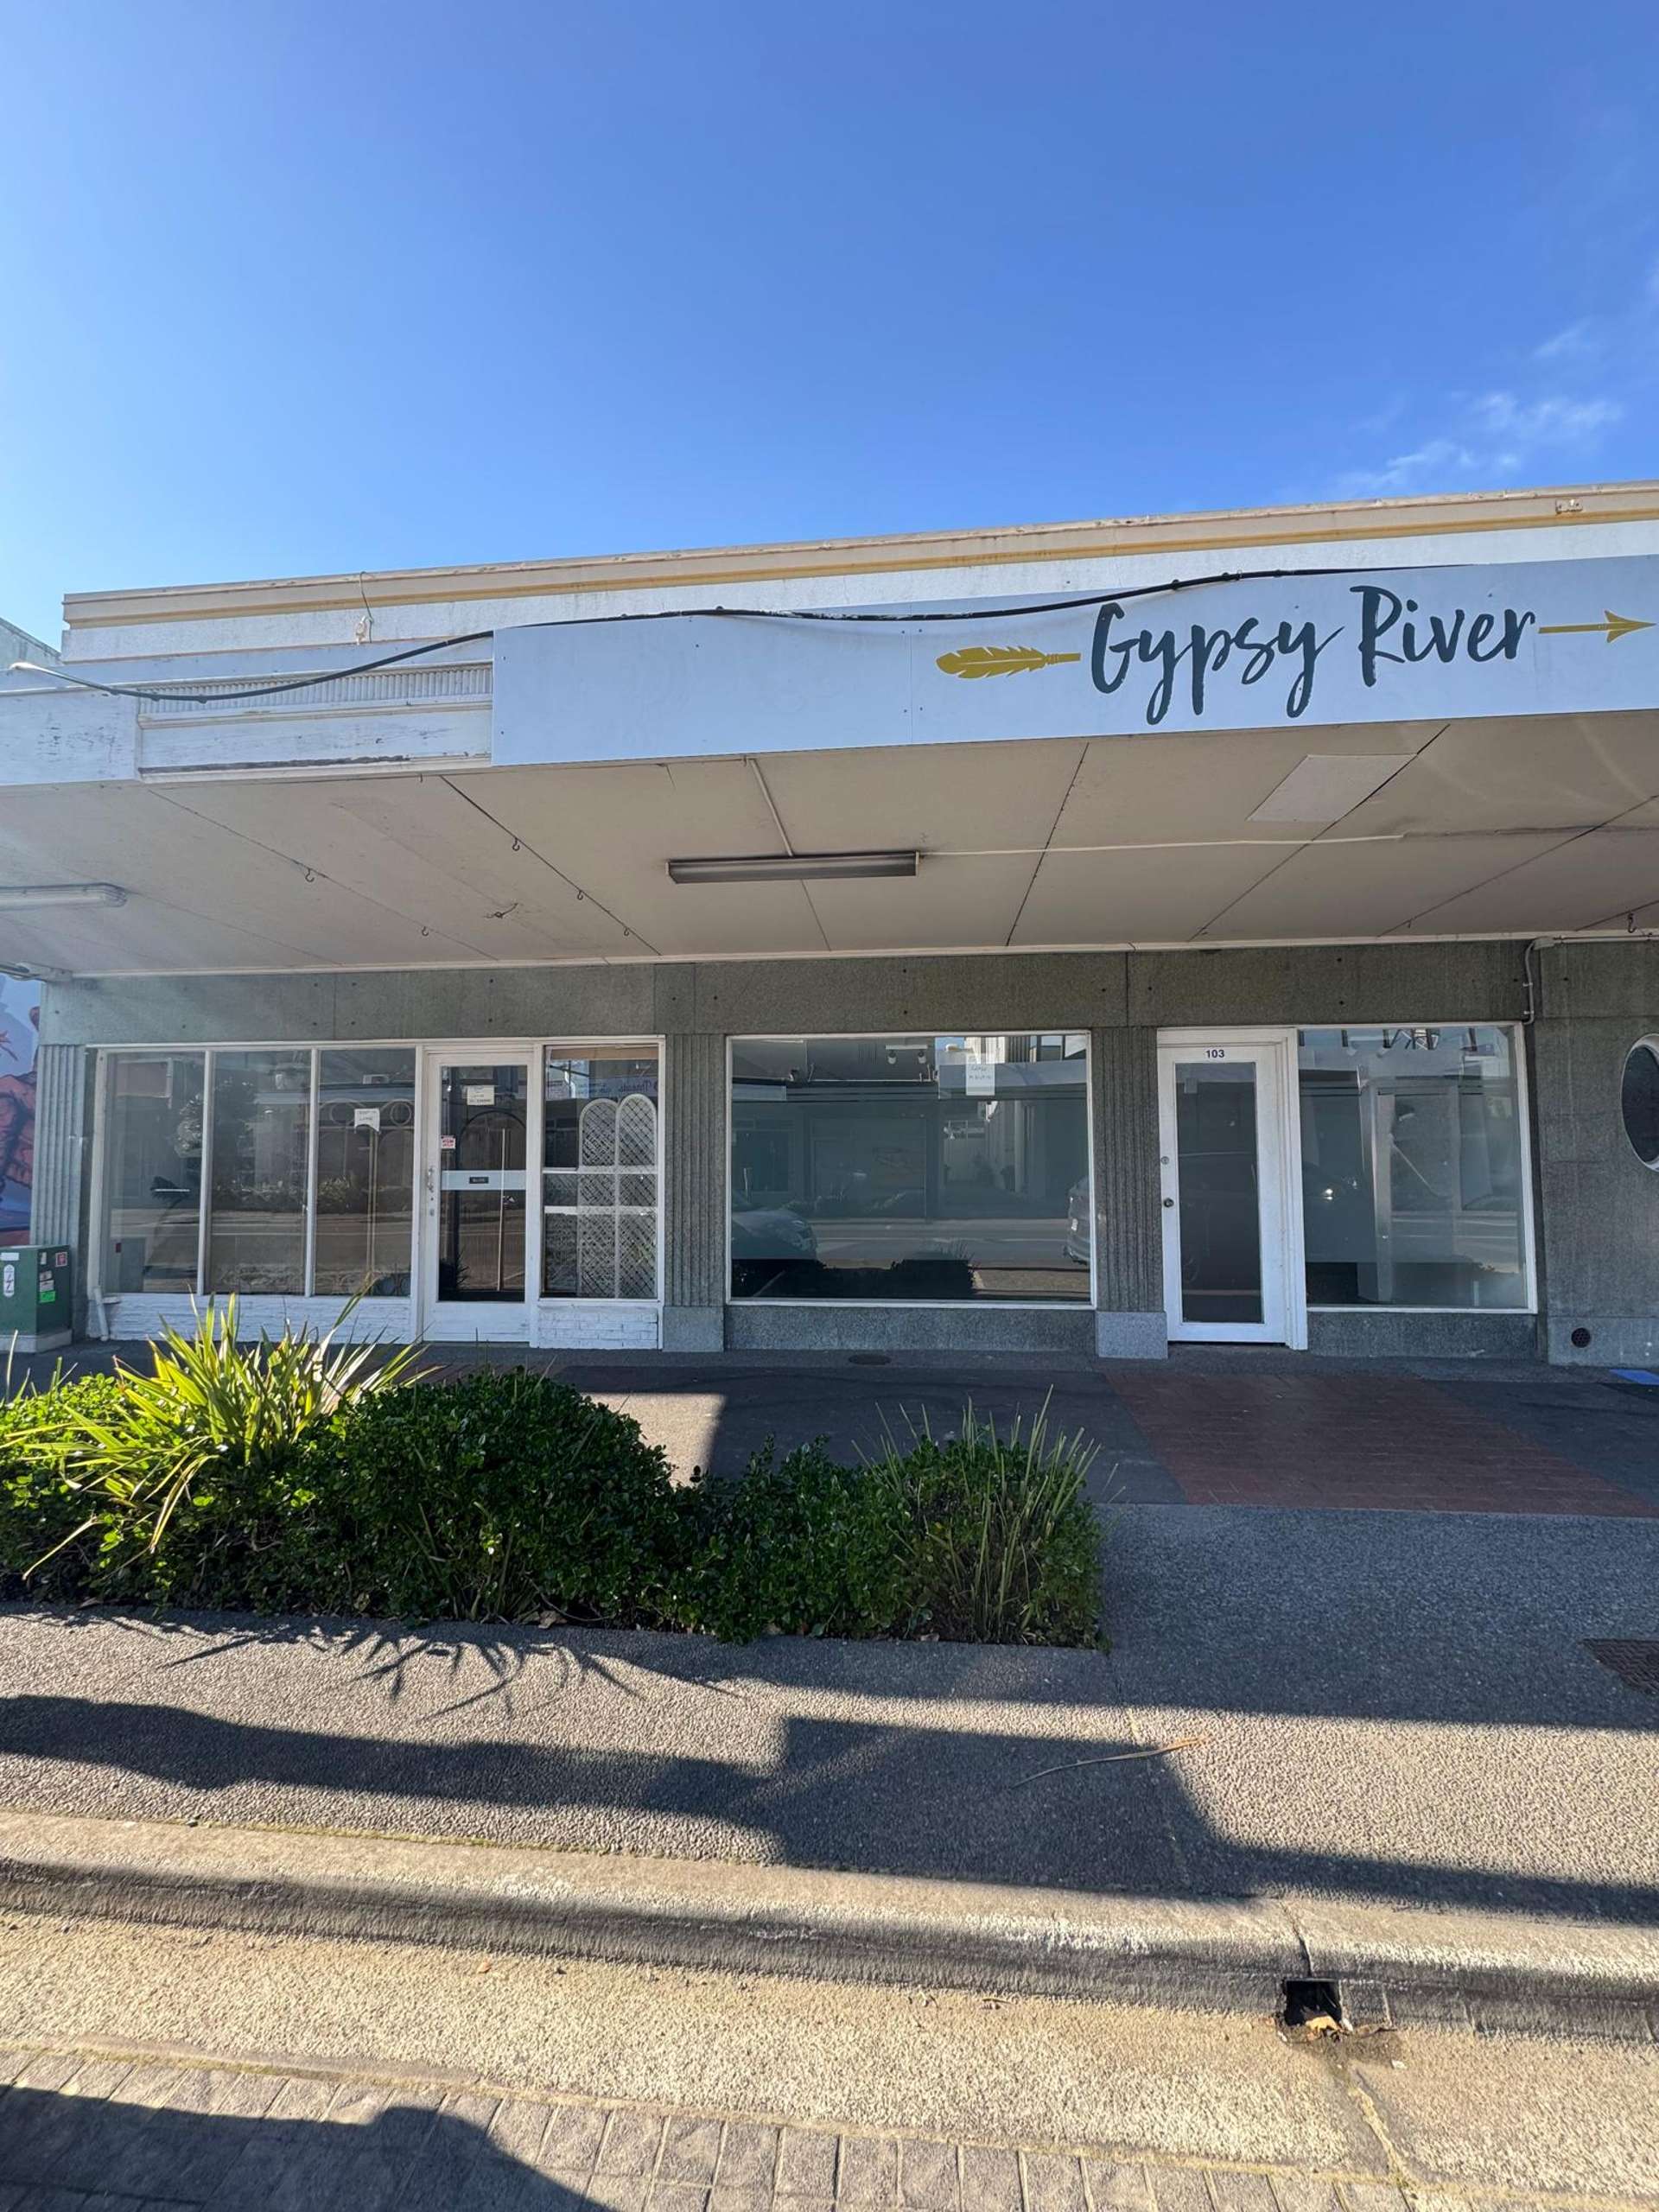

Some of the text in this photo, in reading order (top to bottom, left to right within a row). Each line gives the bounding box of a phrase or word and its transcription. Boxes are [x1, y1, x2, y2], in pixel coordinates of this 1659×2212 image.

[1090, 585, 1536, 726] Gypsy River
[1205, 1049, 1225, 1058] 103
